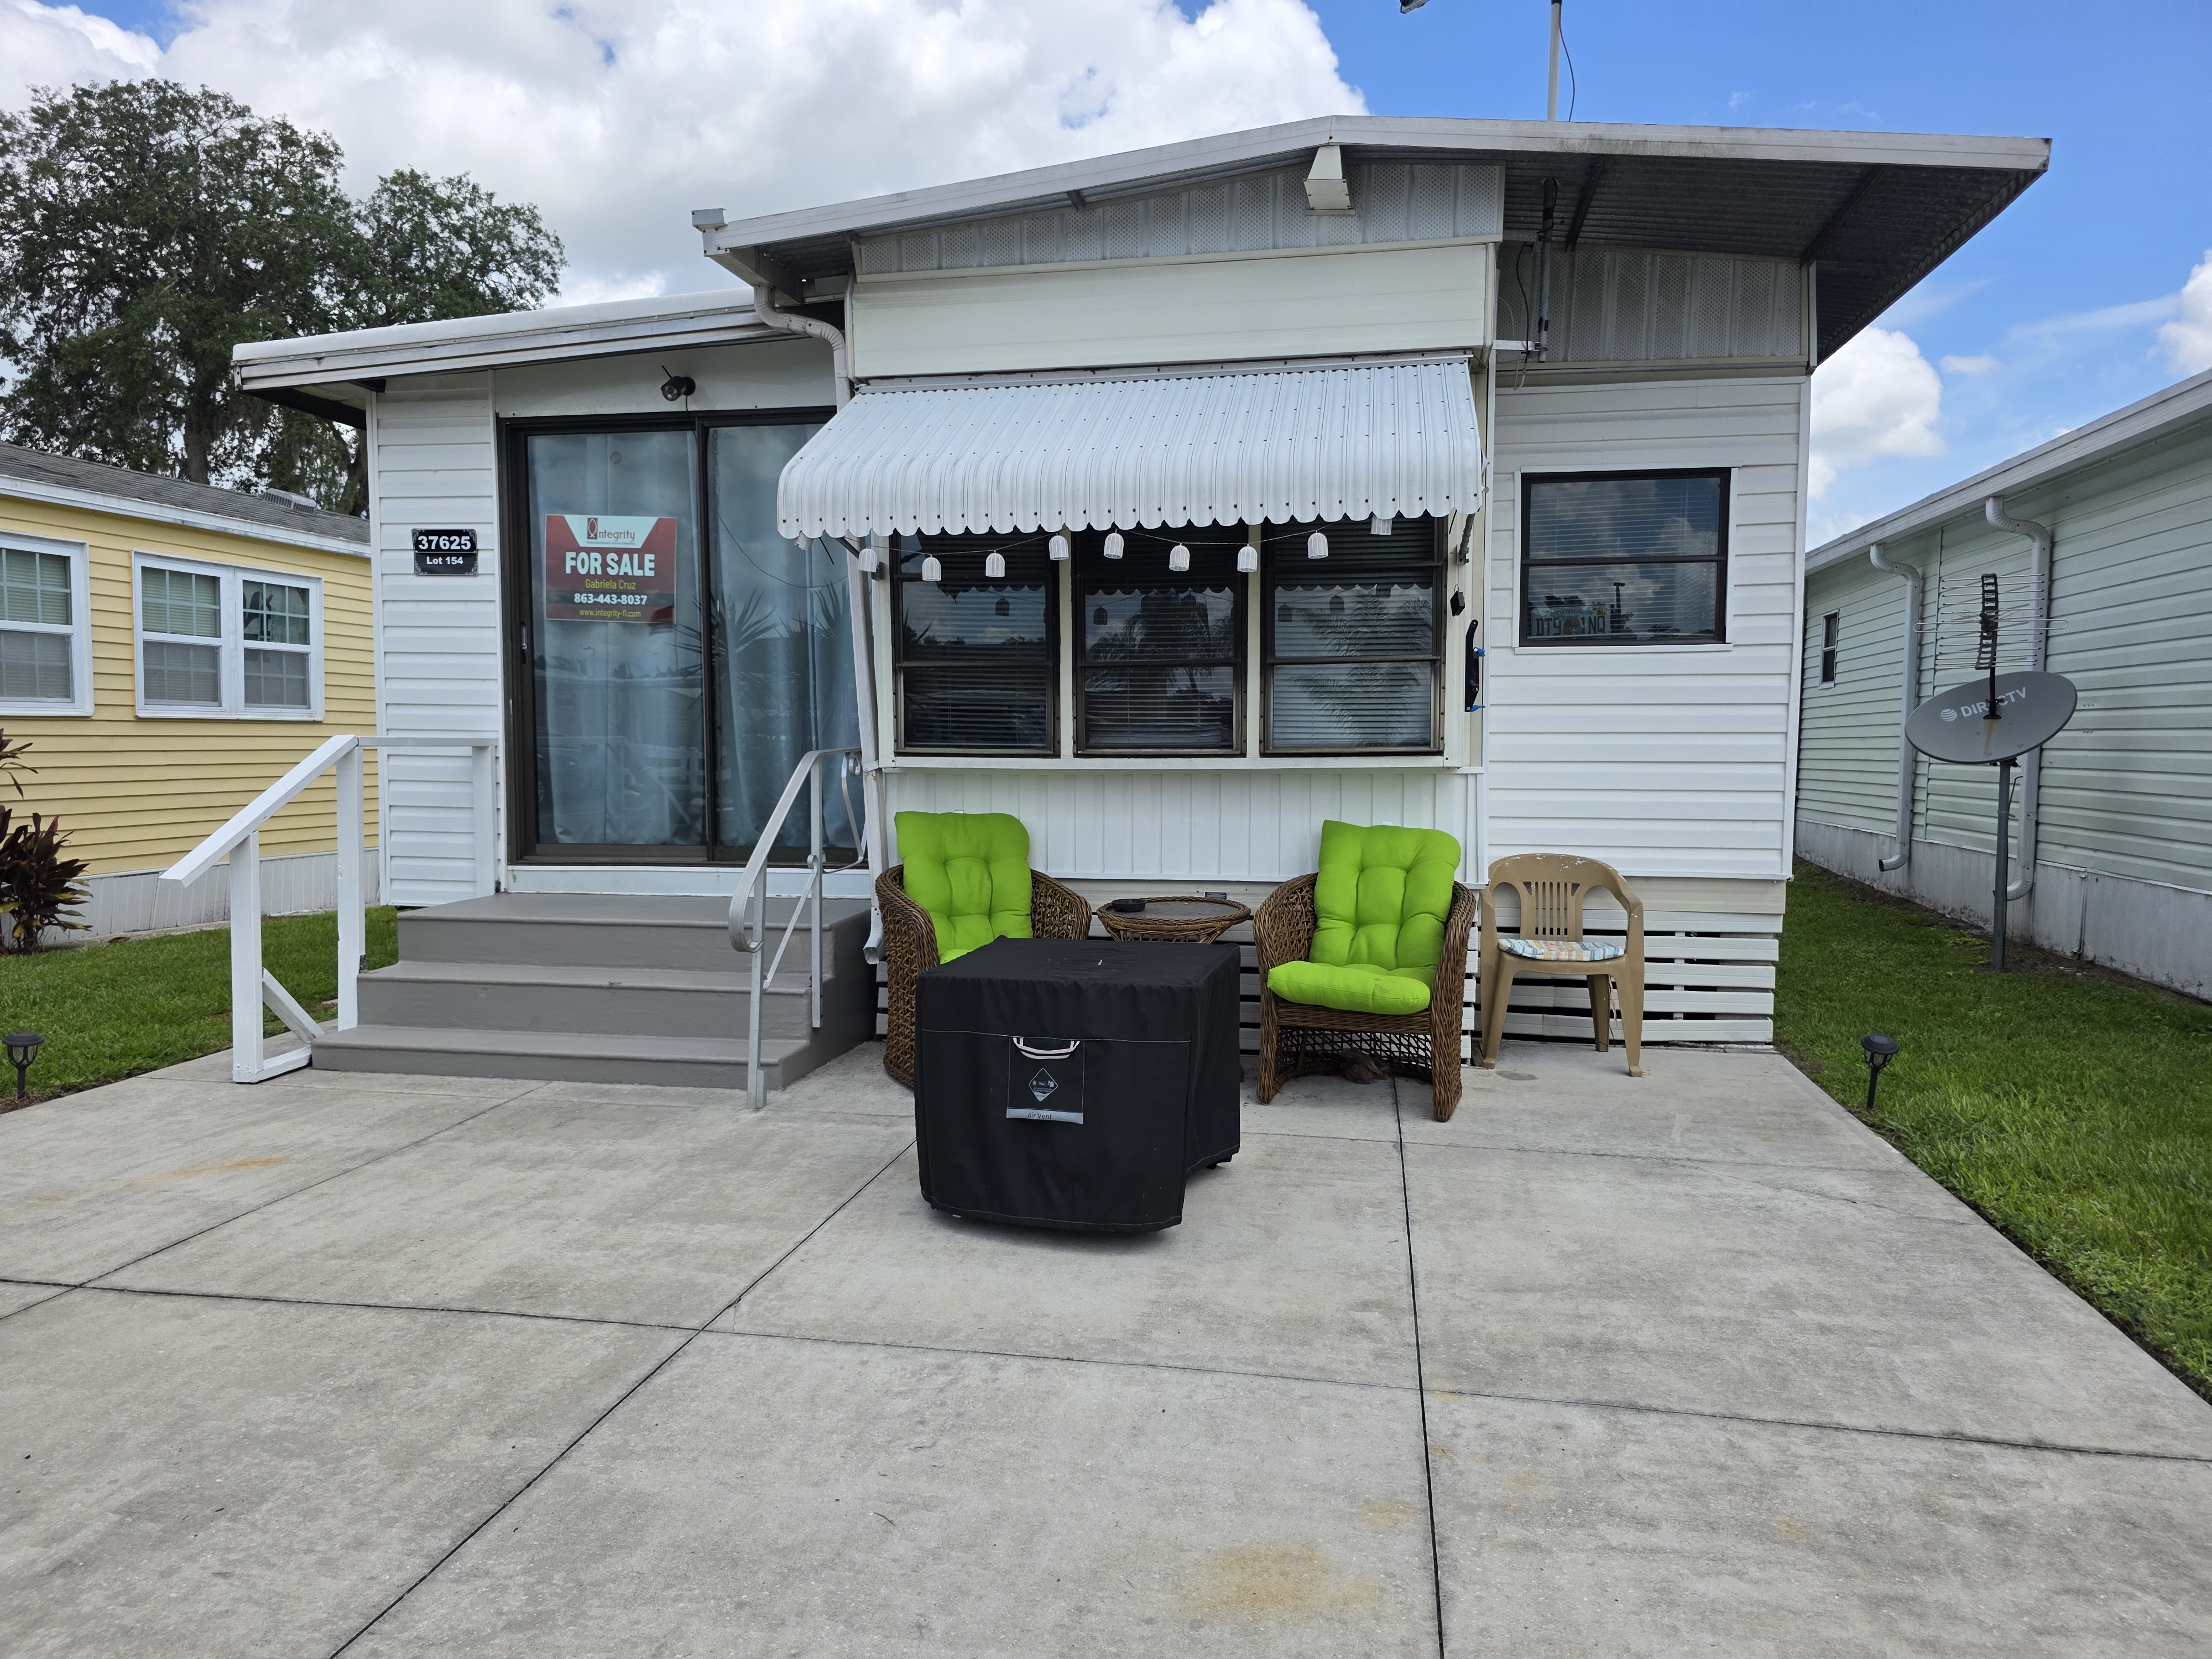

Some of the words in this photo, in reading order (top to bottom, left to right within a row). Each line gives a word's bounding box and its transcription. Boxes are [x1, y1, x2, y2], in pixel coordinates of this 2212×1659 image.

[418, 536, 472, 550] 37625
[426, 556, 443, 565] Lot
[446, 556, 463, 565] 154
[566, 552, 602, 575] FOR
[607, 552, 655, 576] SALE
[585, 579, 617, 589] Gabriela
[619, 580, 636, 590] Cruz
[574, 593, 648, 605] 863-443-8037
[579, 609, 641, 618] www.integrity-fl.com
[1960, 686, 2026, 717] DIRCTV
